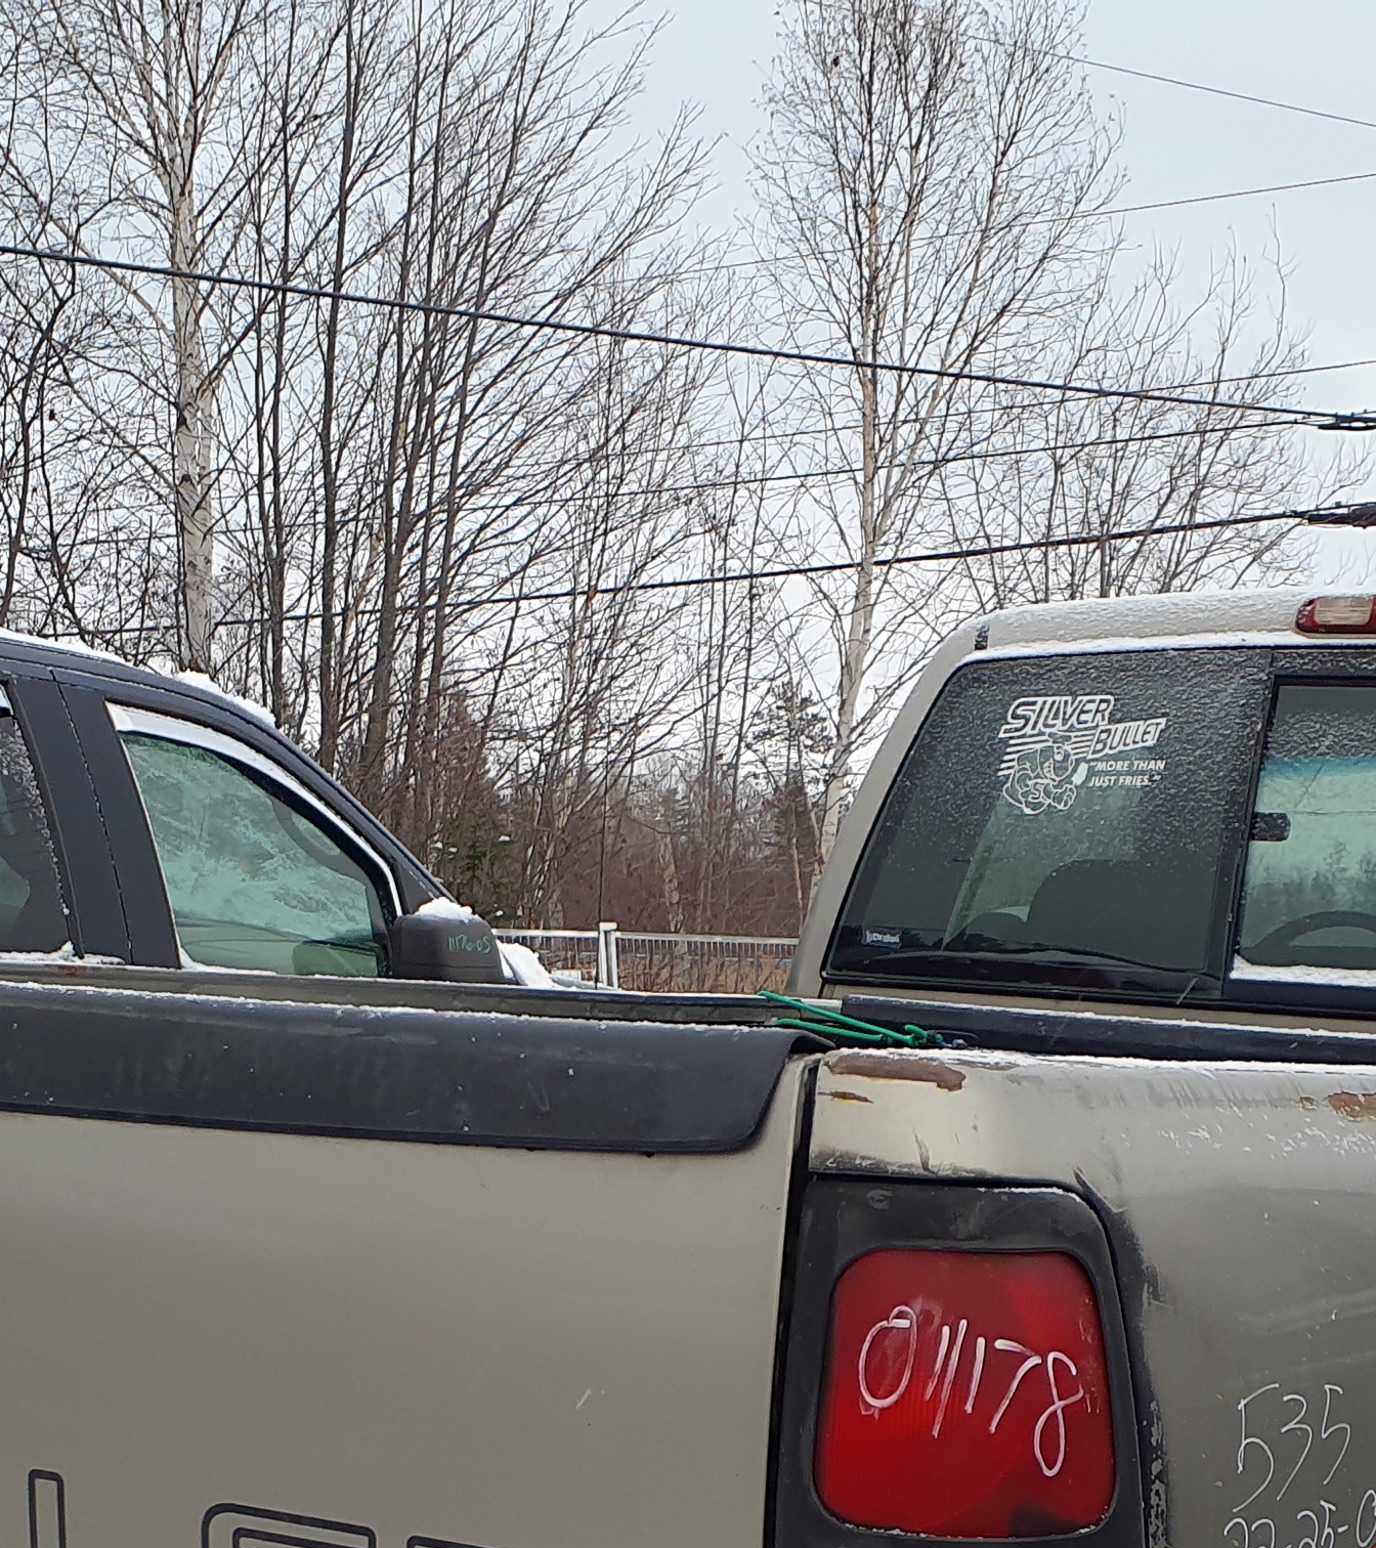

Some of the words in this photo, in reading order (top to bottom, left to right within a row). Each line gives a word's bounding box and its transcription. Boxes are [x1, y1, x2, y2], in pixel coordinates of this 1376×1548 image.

[998, 695, 1114, 738] SILVER
[1087, 718, 1167, 759] BULLET
[1088, 775, 1116, 787] JUST
[1133, 759, 1166, 771] THAN
[858, 1305, 1084, 1478] 011178
[1232, 1383, 1352, 1513] 535
